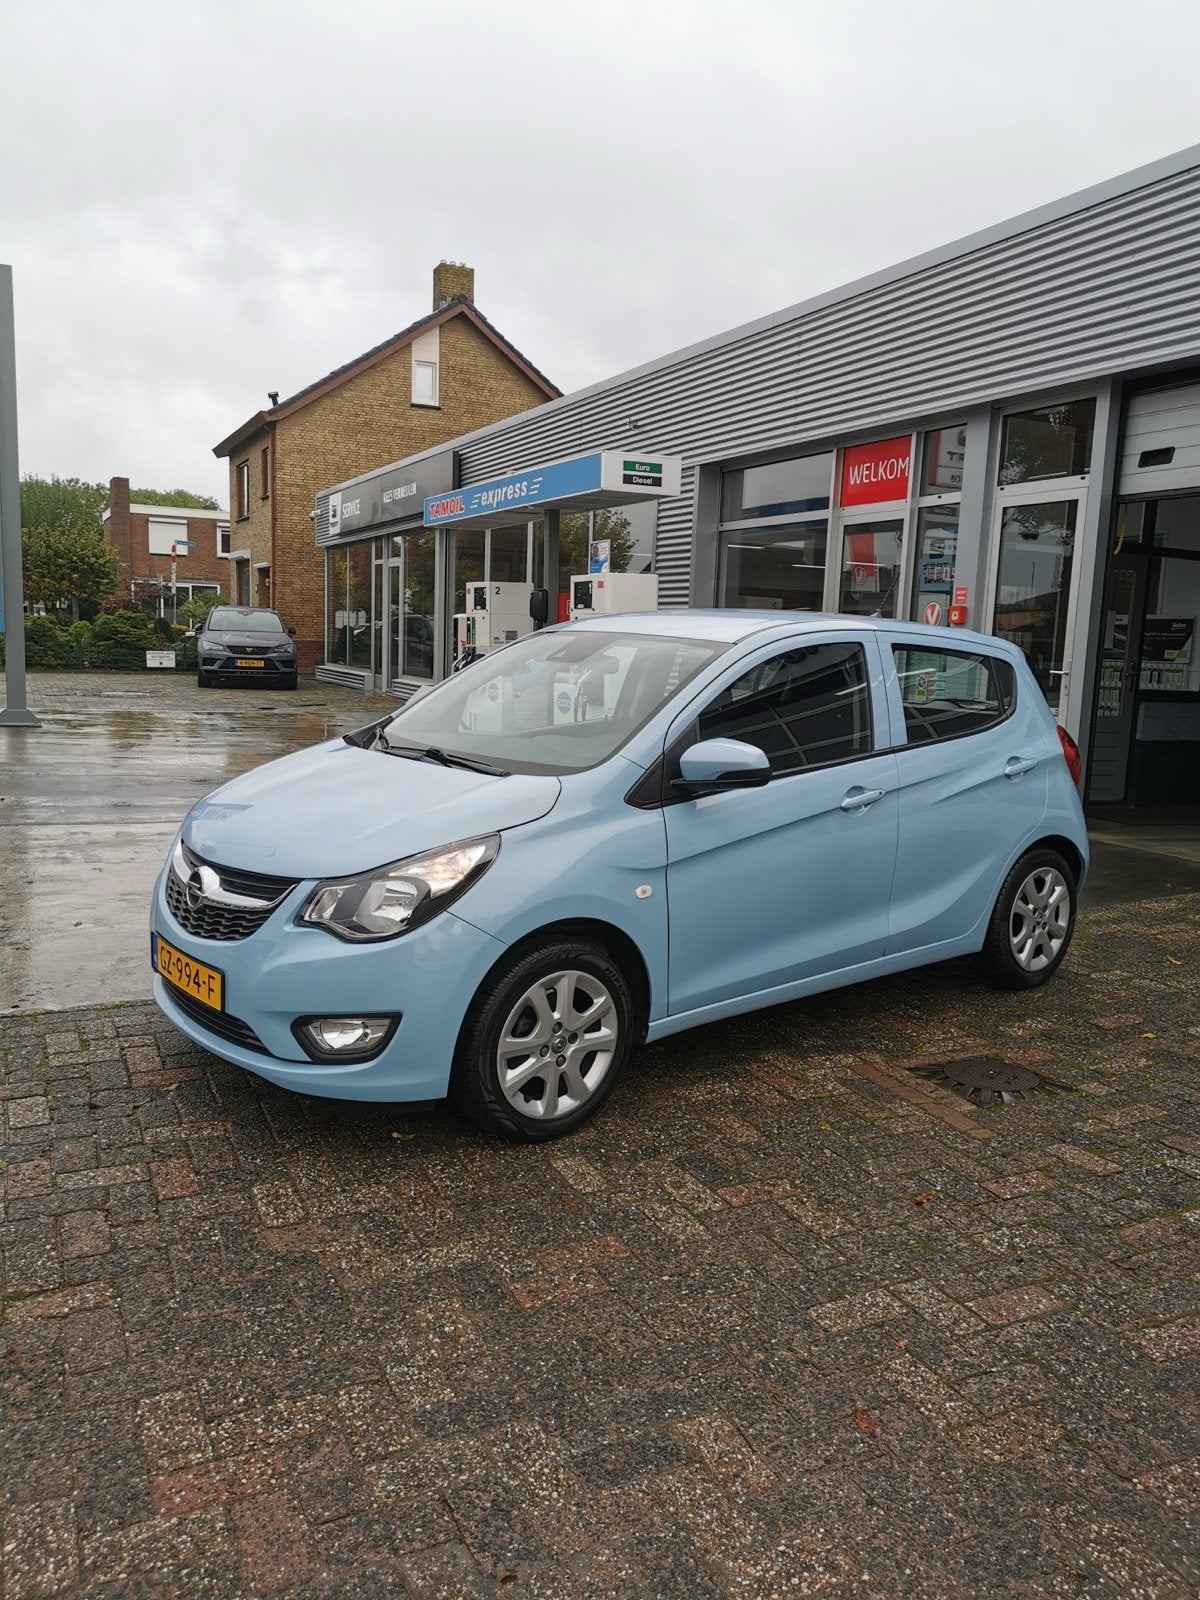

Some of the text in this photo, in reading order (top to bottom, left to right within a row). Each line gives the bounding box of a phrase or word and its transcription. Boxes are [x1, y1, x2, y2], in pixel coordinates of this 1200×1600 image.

[635, 463, 651, 471] Euro
[849, 456, 910, 485] WELKOM
[632, 476, 653, 485] Diesel
[342, 499, 360, 519] SERVICE
[429, 481, 528, 519] TAMOIL express
[495, 586, 501, 595] 2
[160, 945, 216, 1000] GZ-994-F
